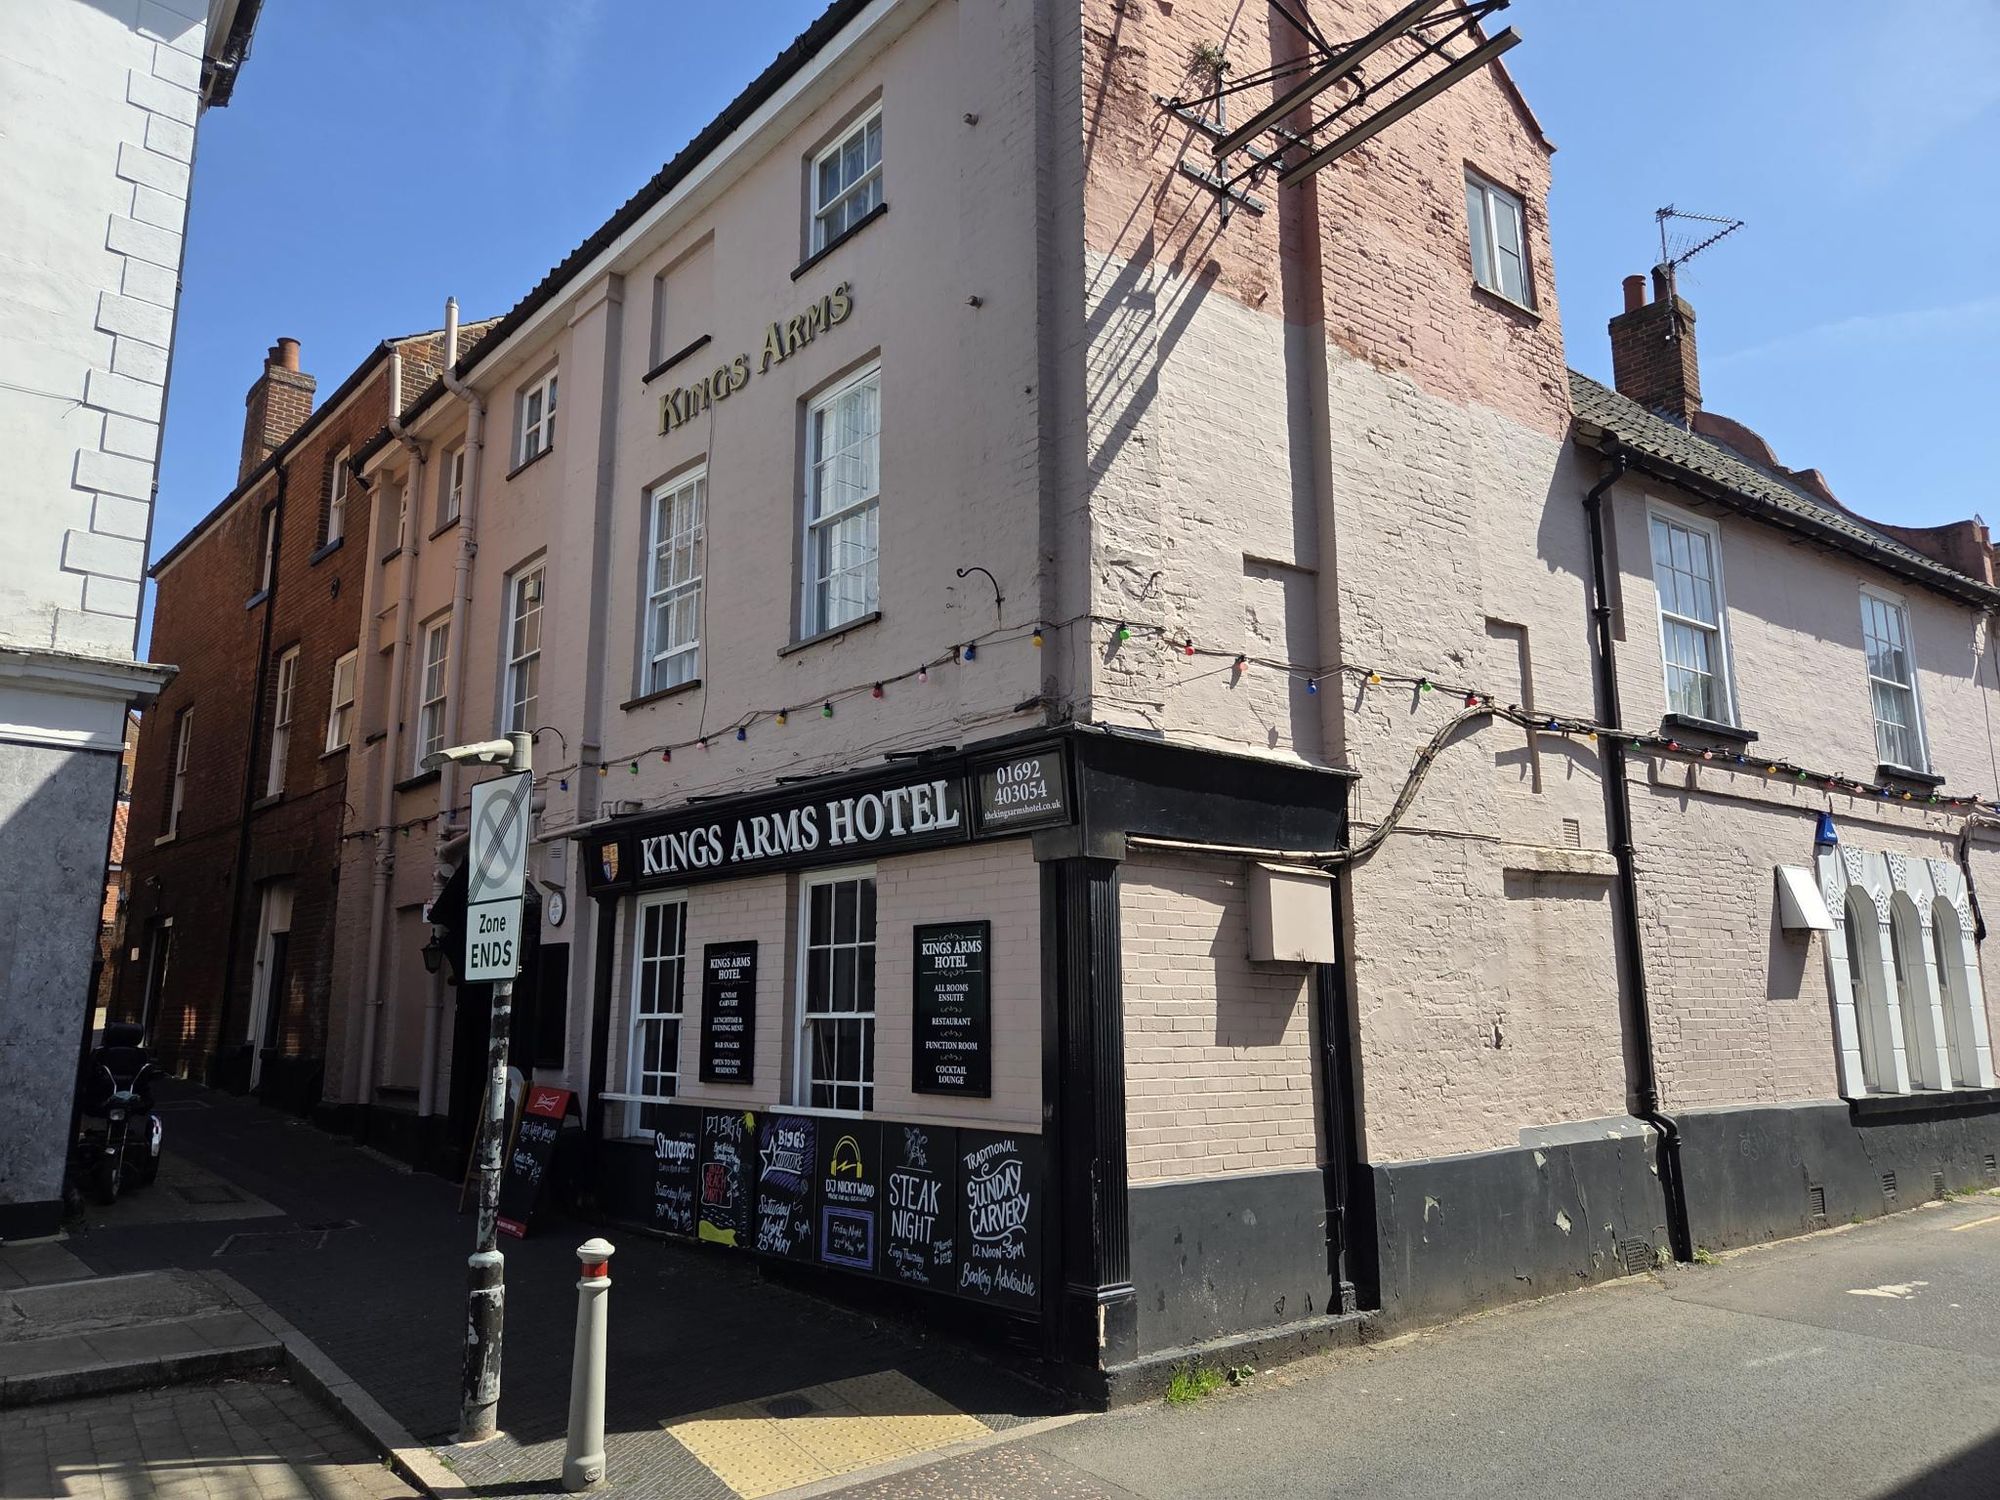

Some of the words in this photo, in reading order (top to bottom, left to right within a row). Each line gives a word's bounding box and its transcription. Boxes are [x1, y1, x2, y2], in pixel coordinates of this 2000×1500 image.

[656, 353, 749, 436] KINGS
[757, 281, 852, 375] ARMS
[996, 760, 1041, 785] 01692
[994, 779, 1048, 806] 403054
[984, 799, 1062, 820] thekingsarmshotel.co.uk
[641, 824, 724, 875] KINGS
[730, 806, 820, 862] ARMS
[829, 780, 960, 847] HOTEL
[479, 913, 506, 934] Zone
[471, 939, 512, 969] ENDS
[922, 942, 952, 955] KINGS
[953, 940, 982, 953] ARMS
[710, 958, 731, 969] KINGS
[731, 956, 751, 968] ARMS
[934, 955, 968, 969] HOTEL
[718, 969, 741, 980] HOTEL
[934, 984, 945, 992] ALL
[946, 983, 969, 992] ROOMS
[938, 993, 964, 1002] ENSUITE
[931, 1017, 972, 1026] RESTAURANT
[925, 1040, 957, 1050] FUNCTION
[958, 1041, 978, 1051] ROOM
[935, 1064, 968, 1075] COCKTAIL
[938, 1075, 965, 1085] LOUNGE
[706, 1115, 718, 1136] DJ
[655, 1132, 696, 1166] Strangers
[963, 1139, 1018, 1170] TRADITIONAL
[825, 1178, 836, 1193] DJ
[837, 1180, 857, 1194] NICKY
[857, 1182, 875, 1198] WOOD
[889, 1173, 942, 1215] STEAK
[967, 1165, 1022, 1210] SUNDAY
[758, 1194, 791, 1230] Saturday
[969, 1193, 1030, 1235] CARVERY
[891, 1210, 936, 1245] NIGHT
[972, 1244, 980, 1257] 12
[960, 1262, 991, 1296] Booking
[993, 1264, 1036, 1297] Advisable
